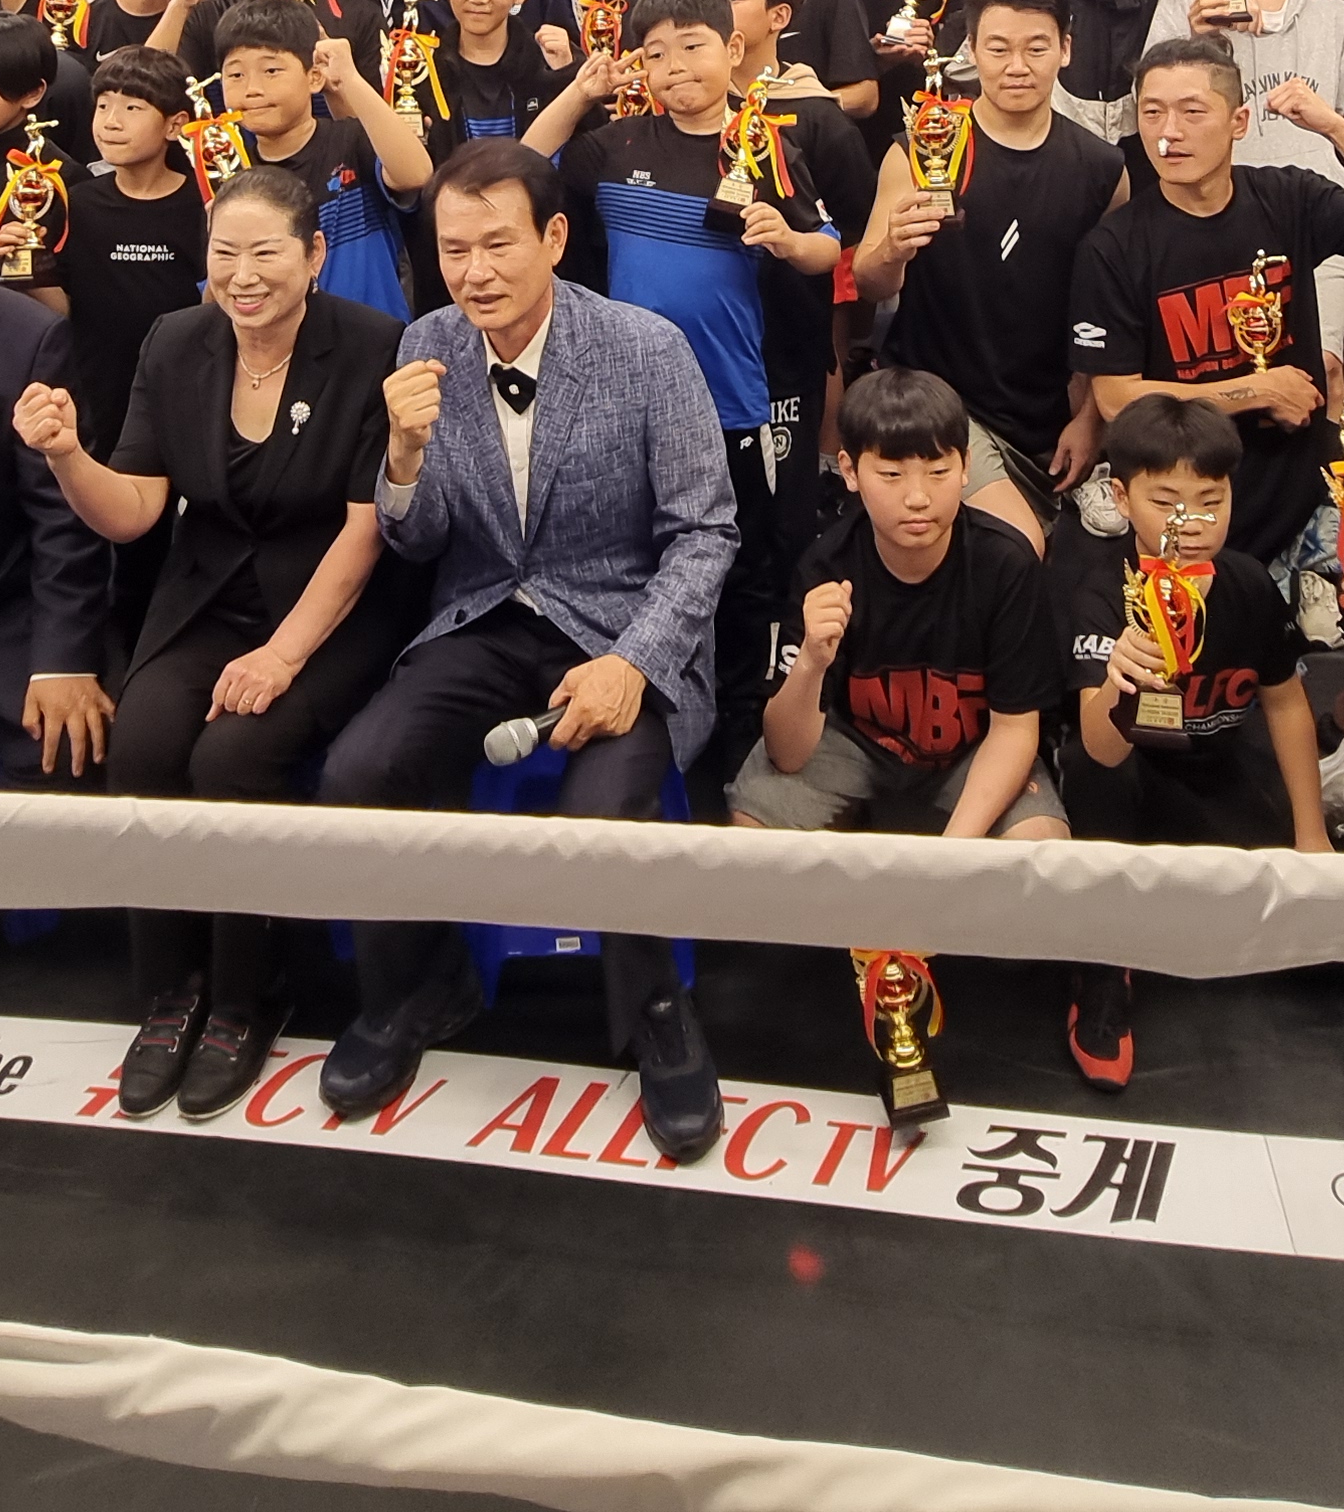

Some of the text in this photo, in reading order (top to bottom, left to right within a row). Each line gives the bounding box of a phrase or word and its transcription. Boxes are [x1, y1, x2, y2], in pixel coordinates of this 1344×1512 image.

[1284, 71, 1320, 94] KIN
[110, 251, 175, 262] GEOGRAPHIC
[116, 244, 169, 253] NATIONAL
[770, 396, 801, 424] IKE
[1185, 669, 1259, 718] LFC
[956, 1125, 1176, 1225] 중계
